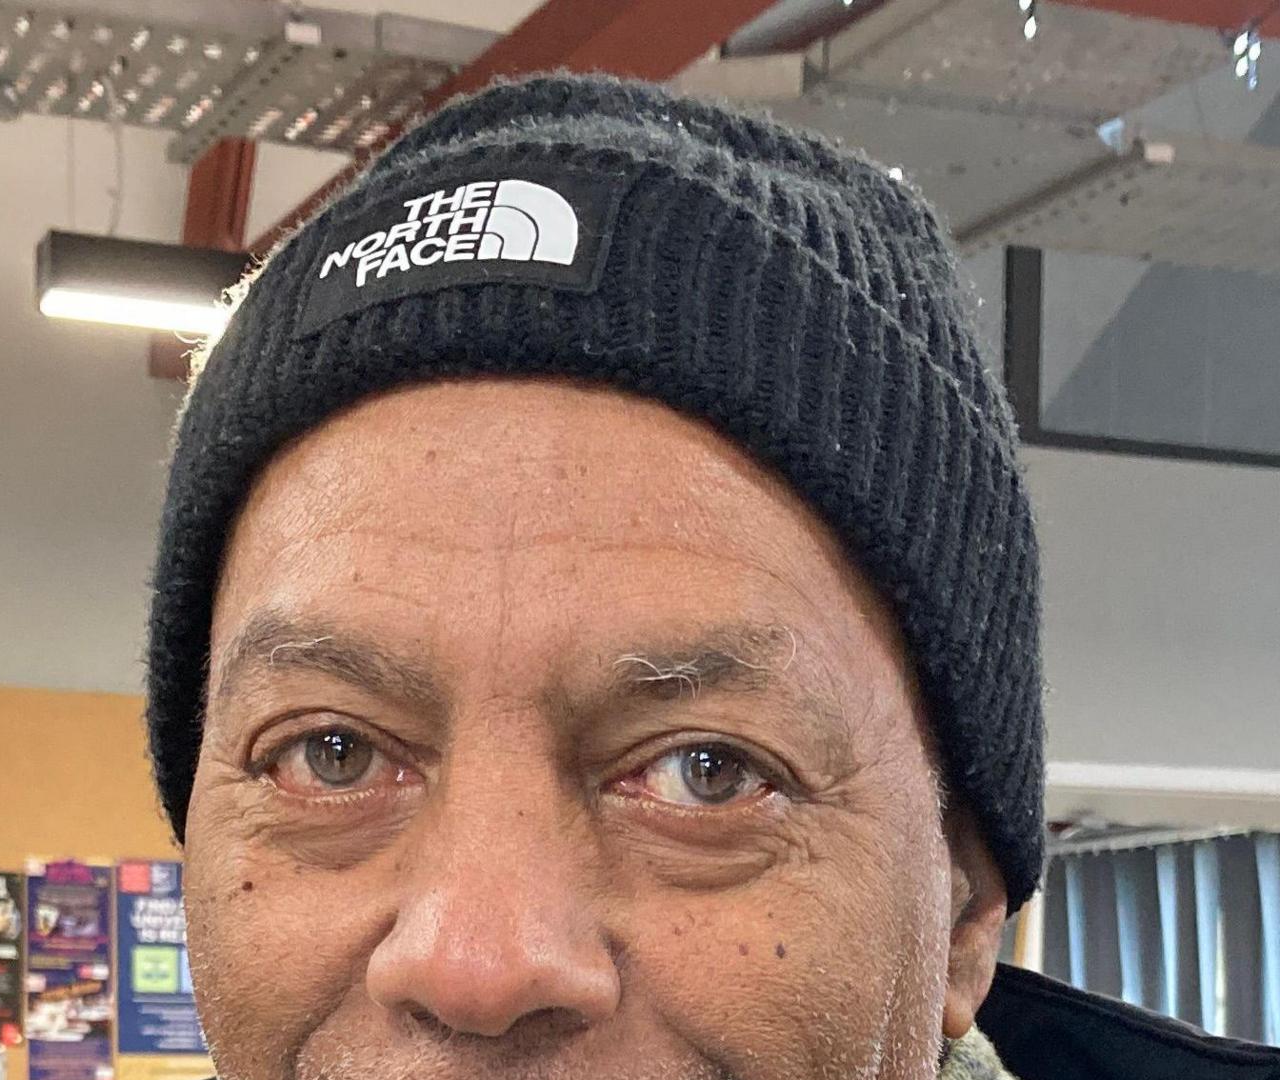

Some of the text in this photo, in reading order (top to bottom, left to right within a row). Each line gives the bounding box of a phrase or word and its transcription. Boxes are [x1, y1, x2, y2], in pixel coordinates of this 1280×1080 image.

[404, 181, 497, 223] THE
[319, 207, 489, 280] NORTH
[356, 232, 481, 288] FACE
